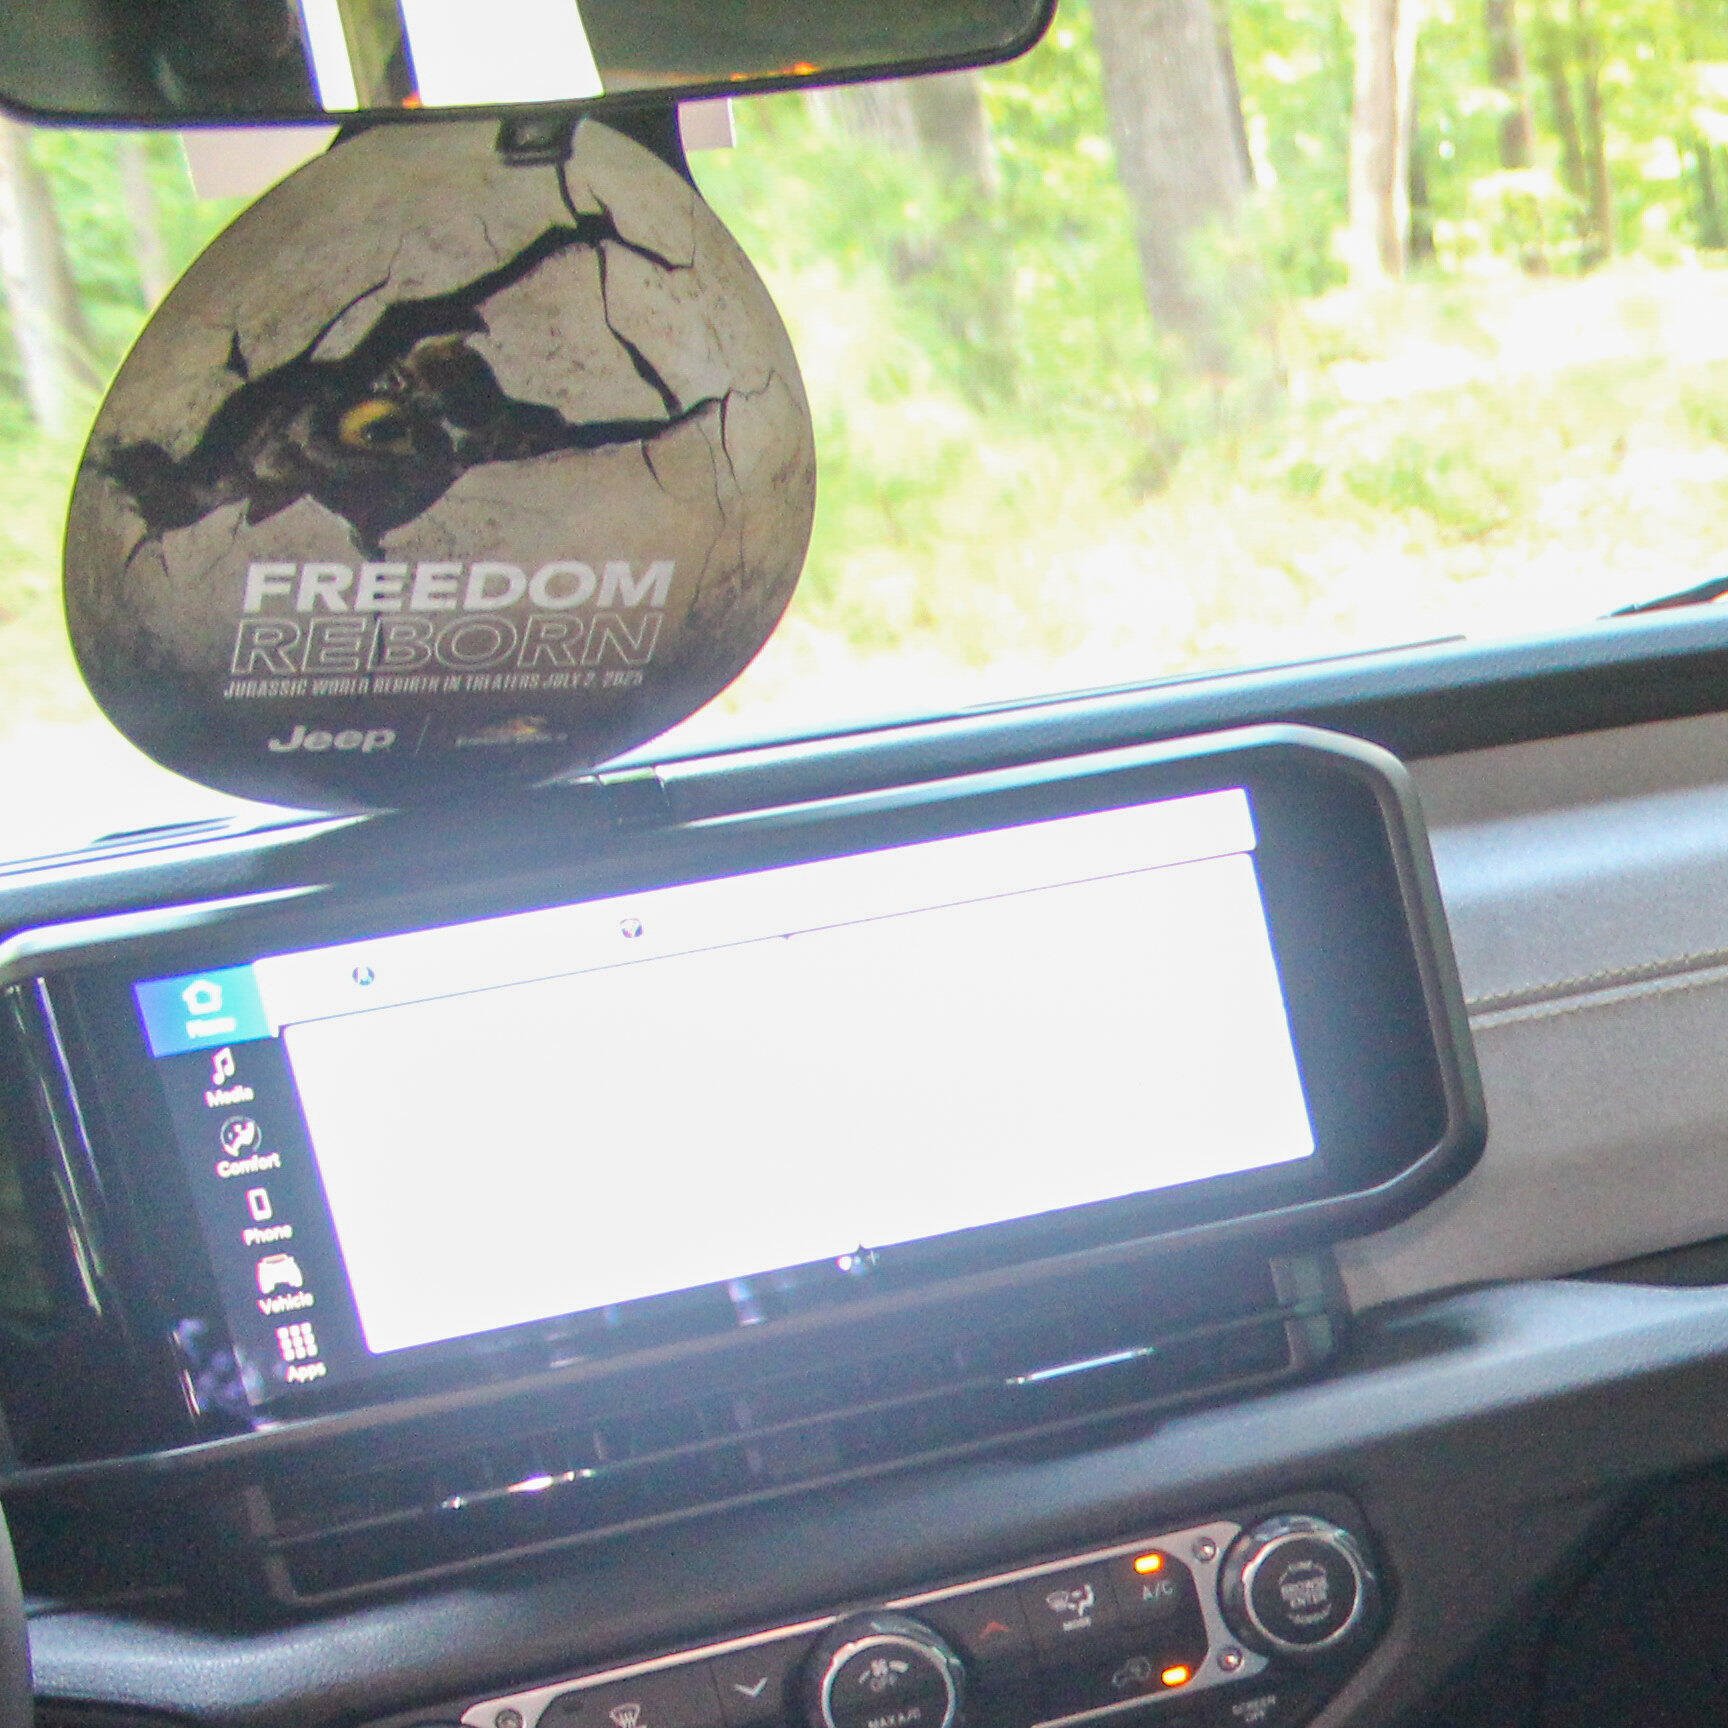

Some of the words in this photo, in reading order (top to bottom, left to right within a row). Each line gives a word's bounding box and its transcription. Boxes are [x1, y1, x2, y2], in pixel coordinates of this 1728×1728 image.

[242, 560, 676, 614] FREEDOM
[230, 611, 664, 676] REBORN
[223, 677, 307, 699] JURASSIC
[268, 724, 397, 755] Jeep
[205, 1082, 254, 1108] Media
[216, 1152, 281, 1178] Comfort
[242, 1220, 293, 1245] Phone
[258, 1289, 314, 1315] Vehicle
[285, 1359, 327, 1384] Apps
[1143, 1581, 1173, 1601] A/C
